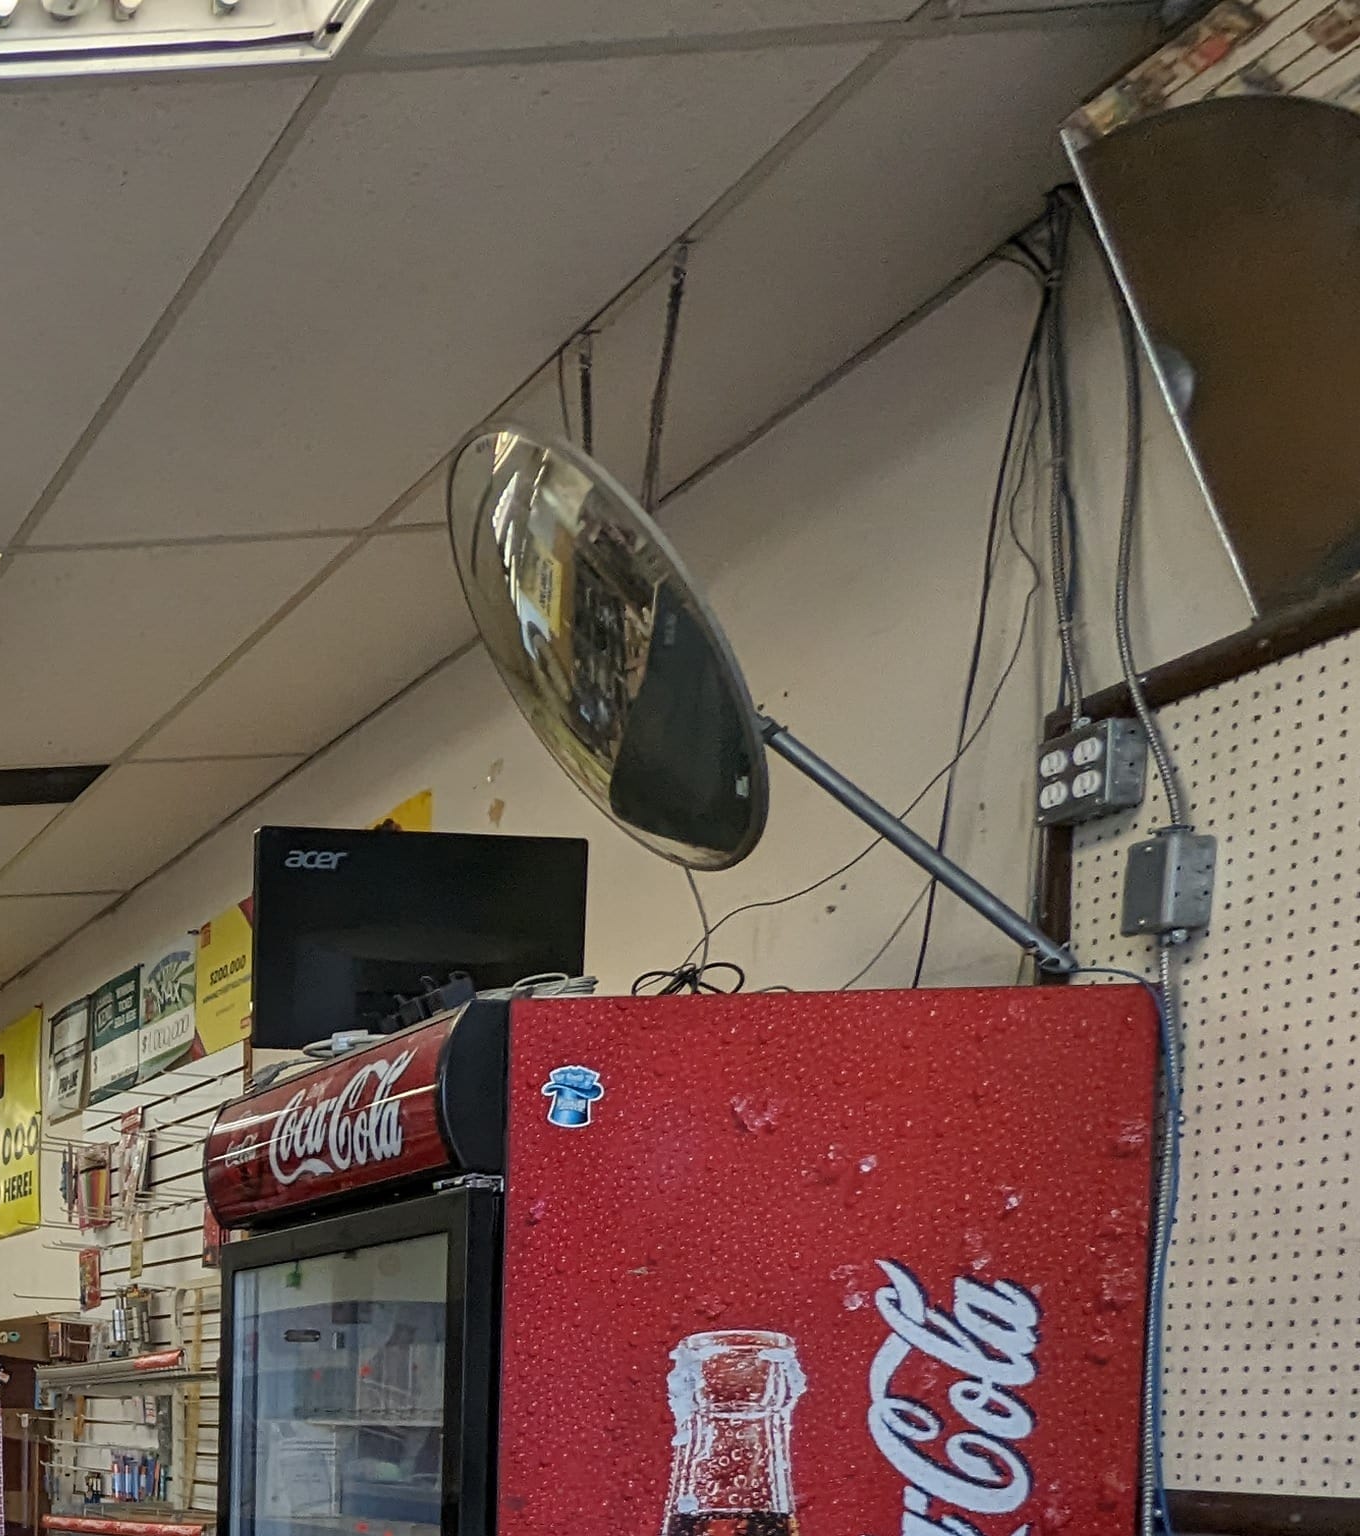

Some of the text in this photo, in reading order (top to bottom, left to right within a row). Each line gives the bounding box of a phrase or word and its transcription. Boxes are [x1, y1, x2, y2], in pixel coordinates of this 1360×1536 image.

[284, 849, 348, 869] acer
[269, 1047, 417, 1185] Coca-Cola
[3, 1171, 33, 1204] HERE!
